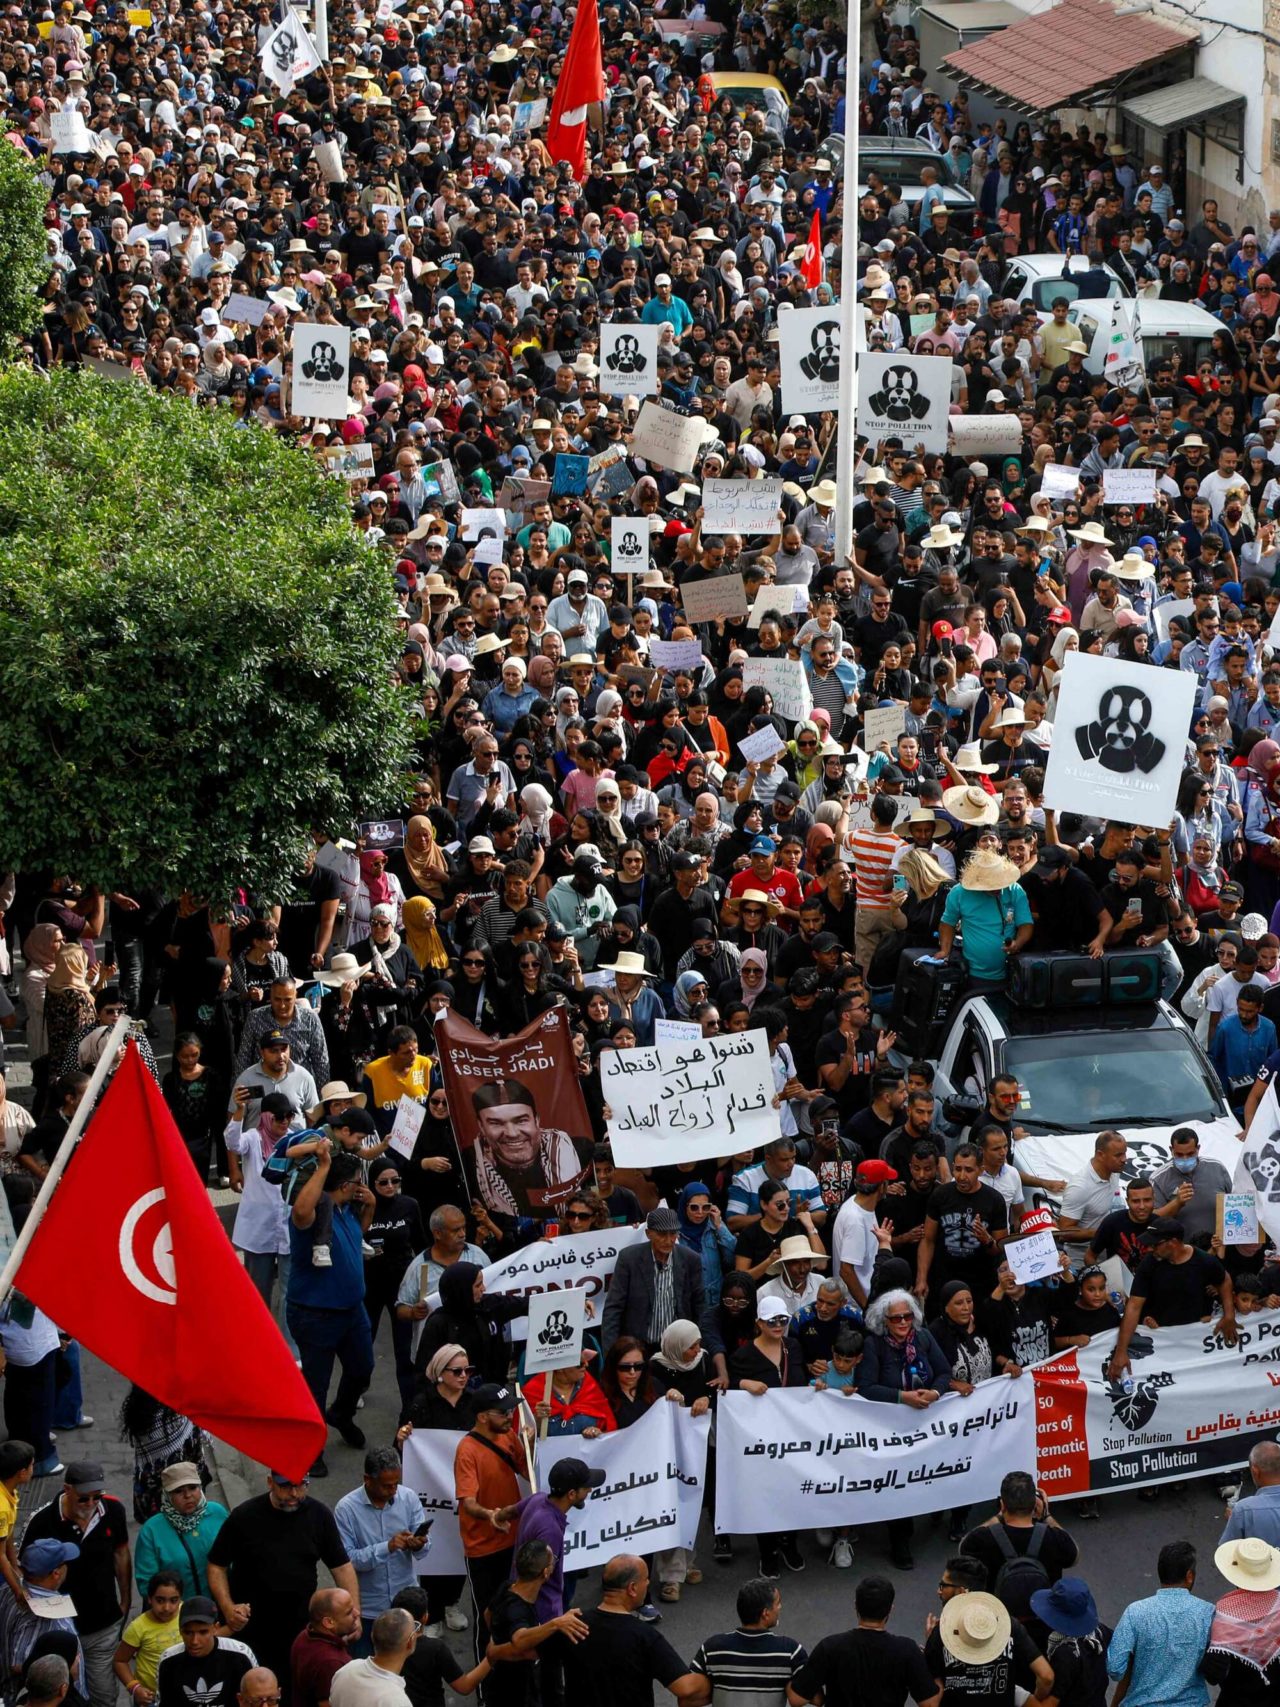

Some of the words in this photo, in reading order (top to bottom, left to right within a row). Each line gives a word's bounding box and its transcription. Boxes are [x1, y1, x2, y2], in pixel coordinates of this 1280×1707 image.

[799, 383, 820, 392] STOP
[865, 420, 886, 429] STOP
[887, 421, 932, 431] POLLUTION
[1097, 771, 1161, 793] POLLUTION
[449, 1048, 500, 1064] جرادي
[661, 1048, 706, 1076] هو
[710, 1033, 755, 1072] شنوا
[454, 1064, 505, 1078] ASSER
[510, 1056, 555, 1073] JRADI
[660, 1070, 725, 1100] البلاد
[618, 1103, 661, 1131] العباد
[581, 1247, 617, 1268] هذي
[548, 1343, 574, 1351] POLLUTION
[1038, 1396, 1055, 1410] 50
[1035, 1422, 1059, 1434] ars
[1061, 1414, 1073, 1433] of
[1186, 1411, 1241, 1442] بقابس
[743, 1438, 812, 1459] معروف
[815, 1431, 880, 1456] والقرار
[882, 1428, 929, 1448] خوف
[1036, 1438, 1086, 1459] tematic
[1102, 1436, 1126, 1452] Stop
[1127, 1431, 1173, 1449] Pollution
[1109, 1458, 1139, 1480] Stop
[1141, 1450, 1199, 1474] Pollution
